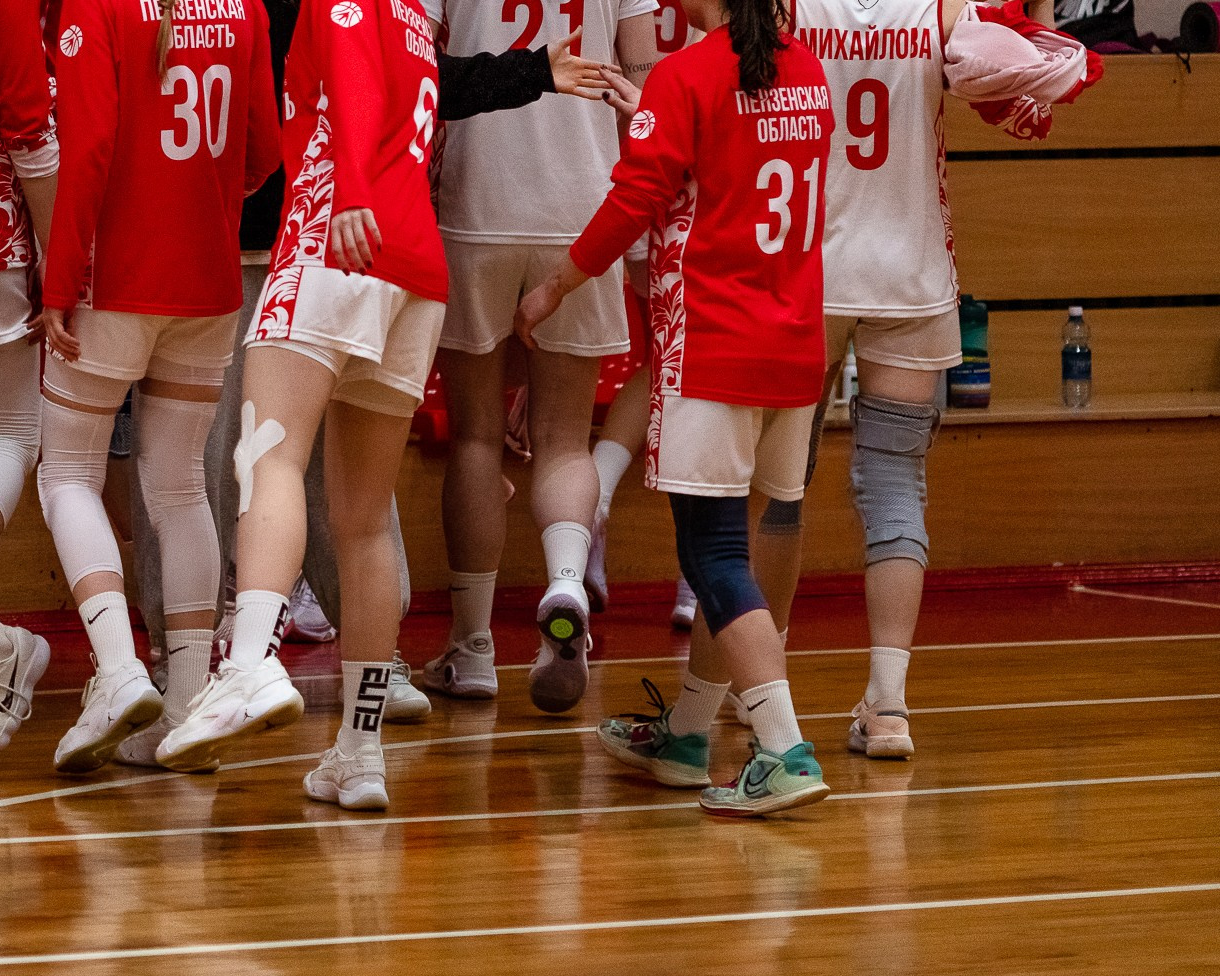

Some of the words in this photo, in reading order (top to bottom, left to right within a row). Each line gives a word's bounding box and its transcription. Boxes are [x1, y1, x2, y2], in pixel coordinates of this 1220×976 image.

[625, 61, 657, 74] Youn
[799, 24, 932, 61] МИХАЙЛОВА
[160, 64, 233, 161] 30
[757, 115, 822, 143] ОБЛАСТЬ
[845, 77, 890, 171] 9
[755, 157, 820, 255] 31
